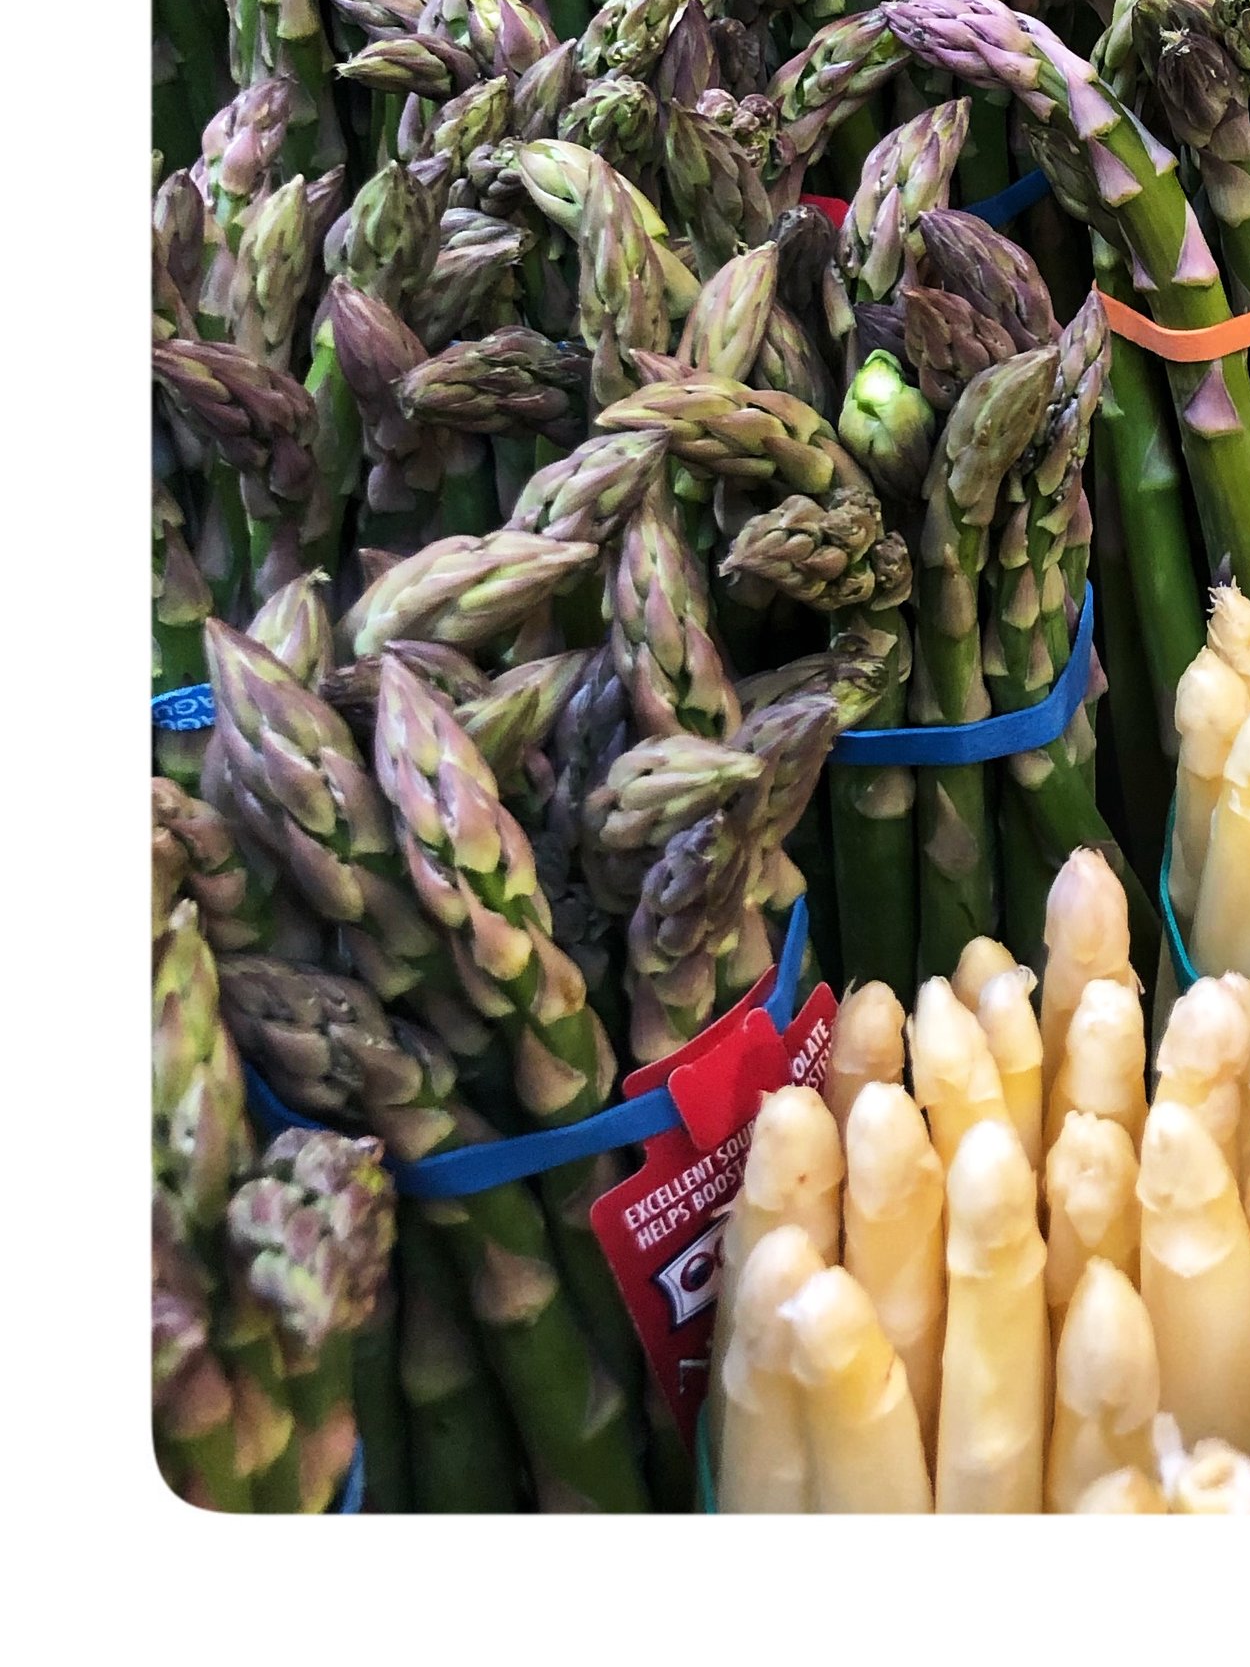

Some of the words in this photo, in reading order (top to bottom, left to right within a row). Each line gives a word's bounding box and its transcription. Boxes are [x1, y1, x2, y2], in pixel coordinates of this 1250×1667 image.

[624, 1154, 715, 1231] EXCELLENT
[791, 1017, 830, 1080] OLATE
[636, 1200, 691, 1252] HELPS
